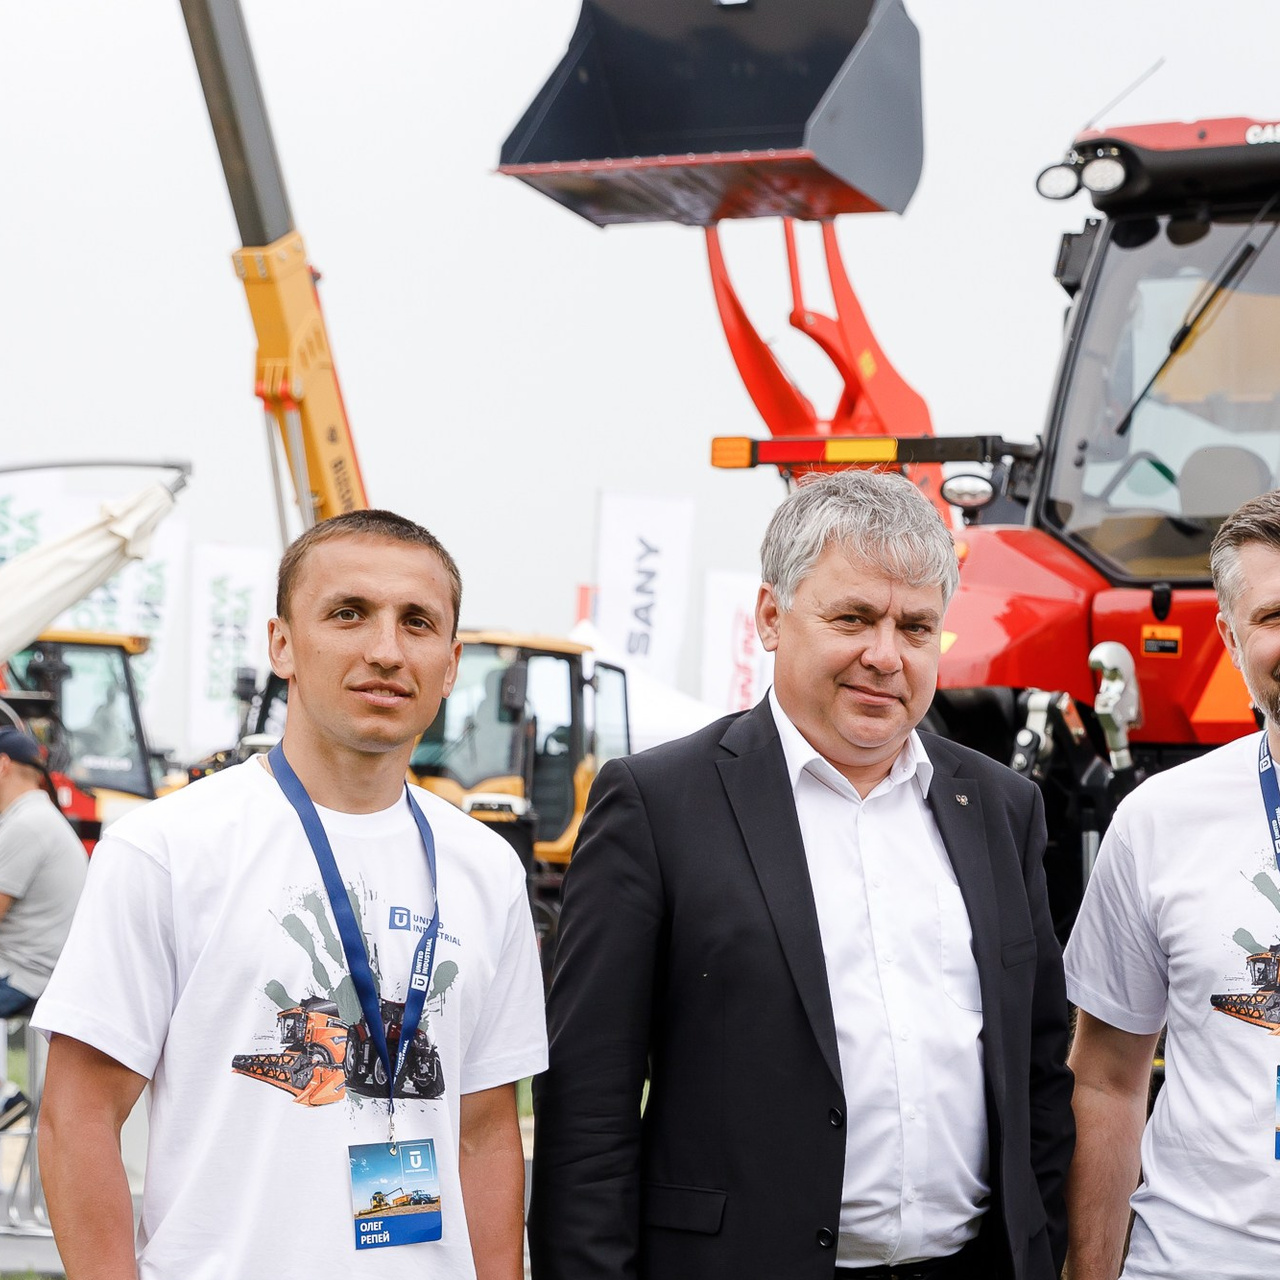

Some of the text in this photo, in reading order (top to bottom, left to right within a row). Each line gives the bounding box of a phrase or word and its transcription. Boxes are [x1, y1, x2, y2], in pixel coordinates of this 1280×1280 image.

[627, 536, 661, 656] SANY
[360, 1221, 383, 1232] ОЛЕГ
[361, 1231, 390, 1245] РЕПЕЙ
